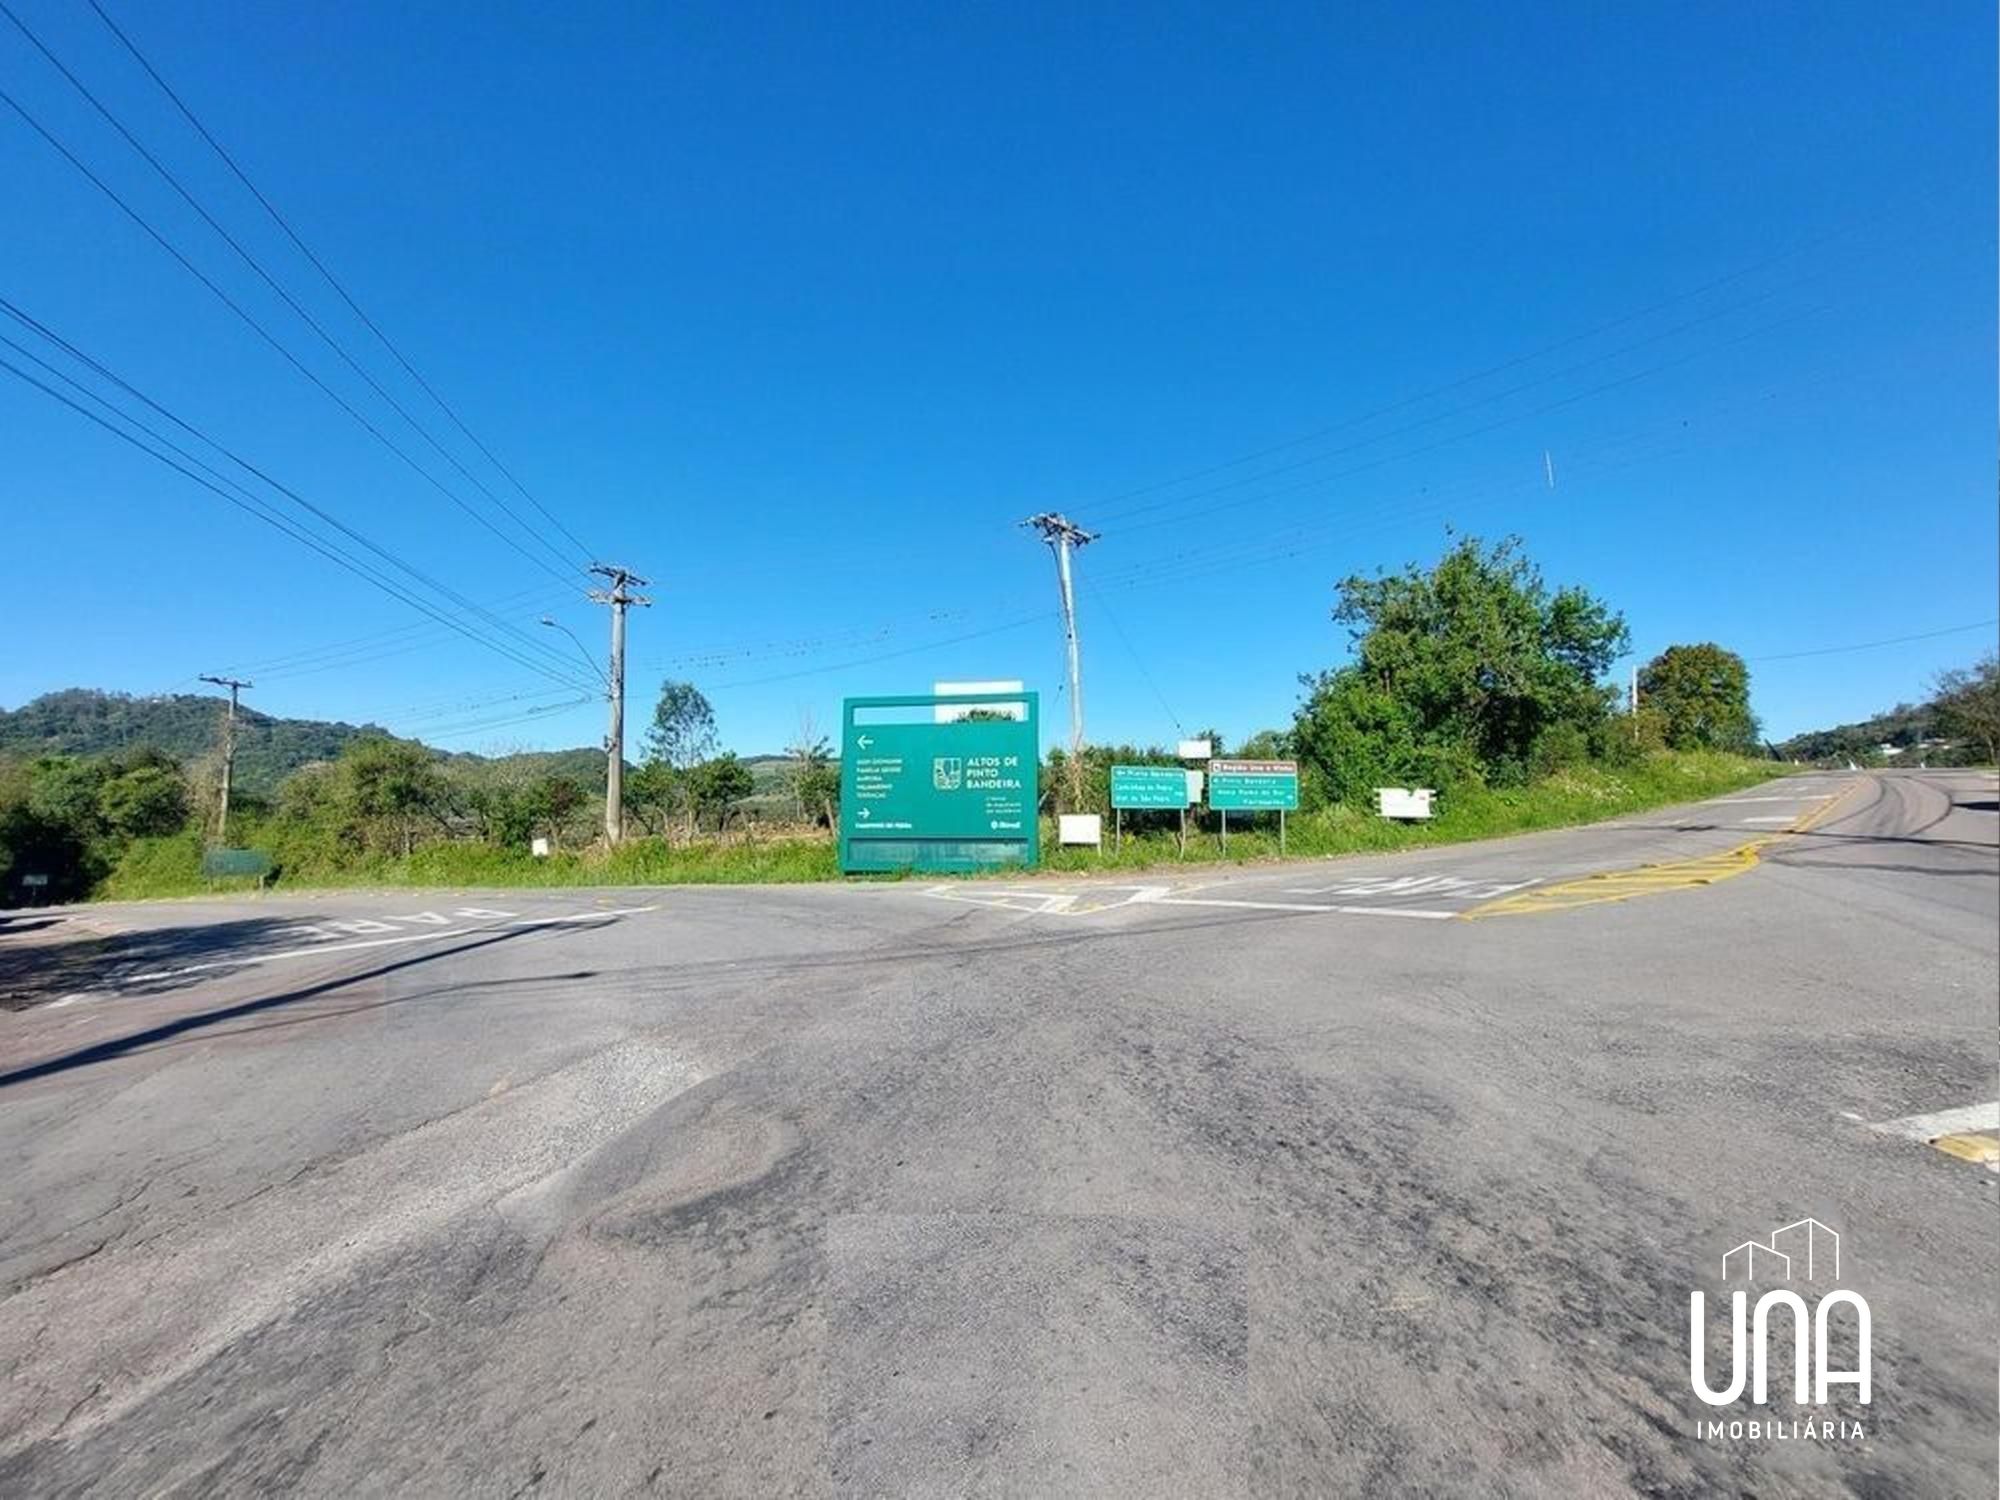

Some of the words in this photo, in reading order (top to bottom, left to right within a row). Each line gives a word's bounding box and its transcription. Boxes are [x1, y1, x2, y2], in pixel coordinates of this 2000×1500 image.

[967, 757, 1001, 767] ALTOS
[1004, 756, 1018, 766] DE
[966, 768, 998, 778] PINTO
[966, 779, 1021, 789] BANDEIRA
